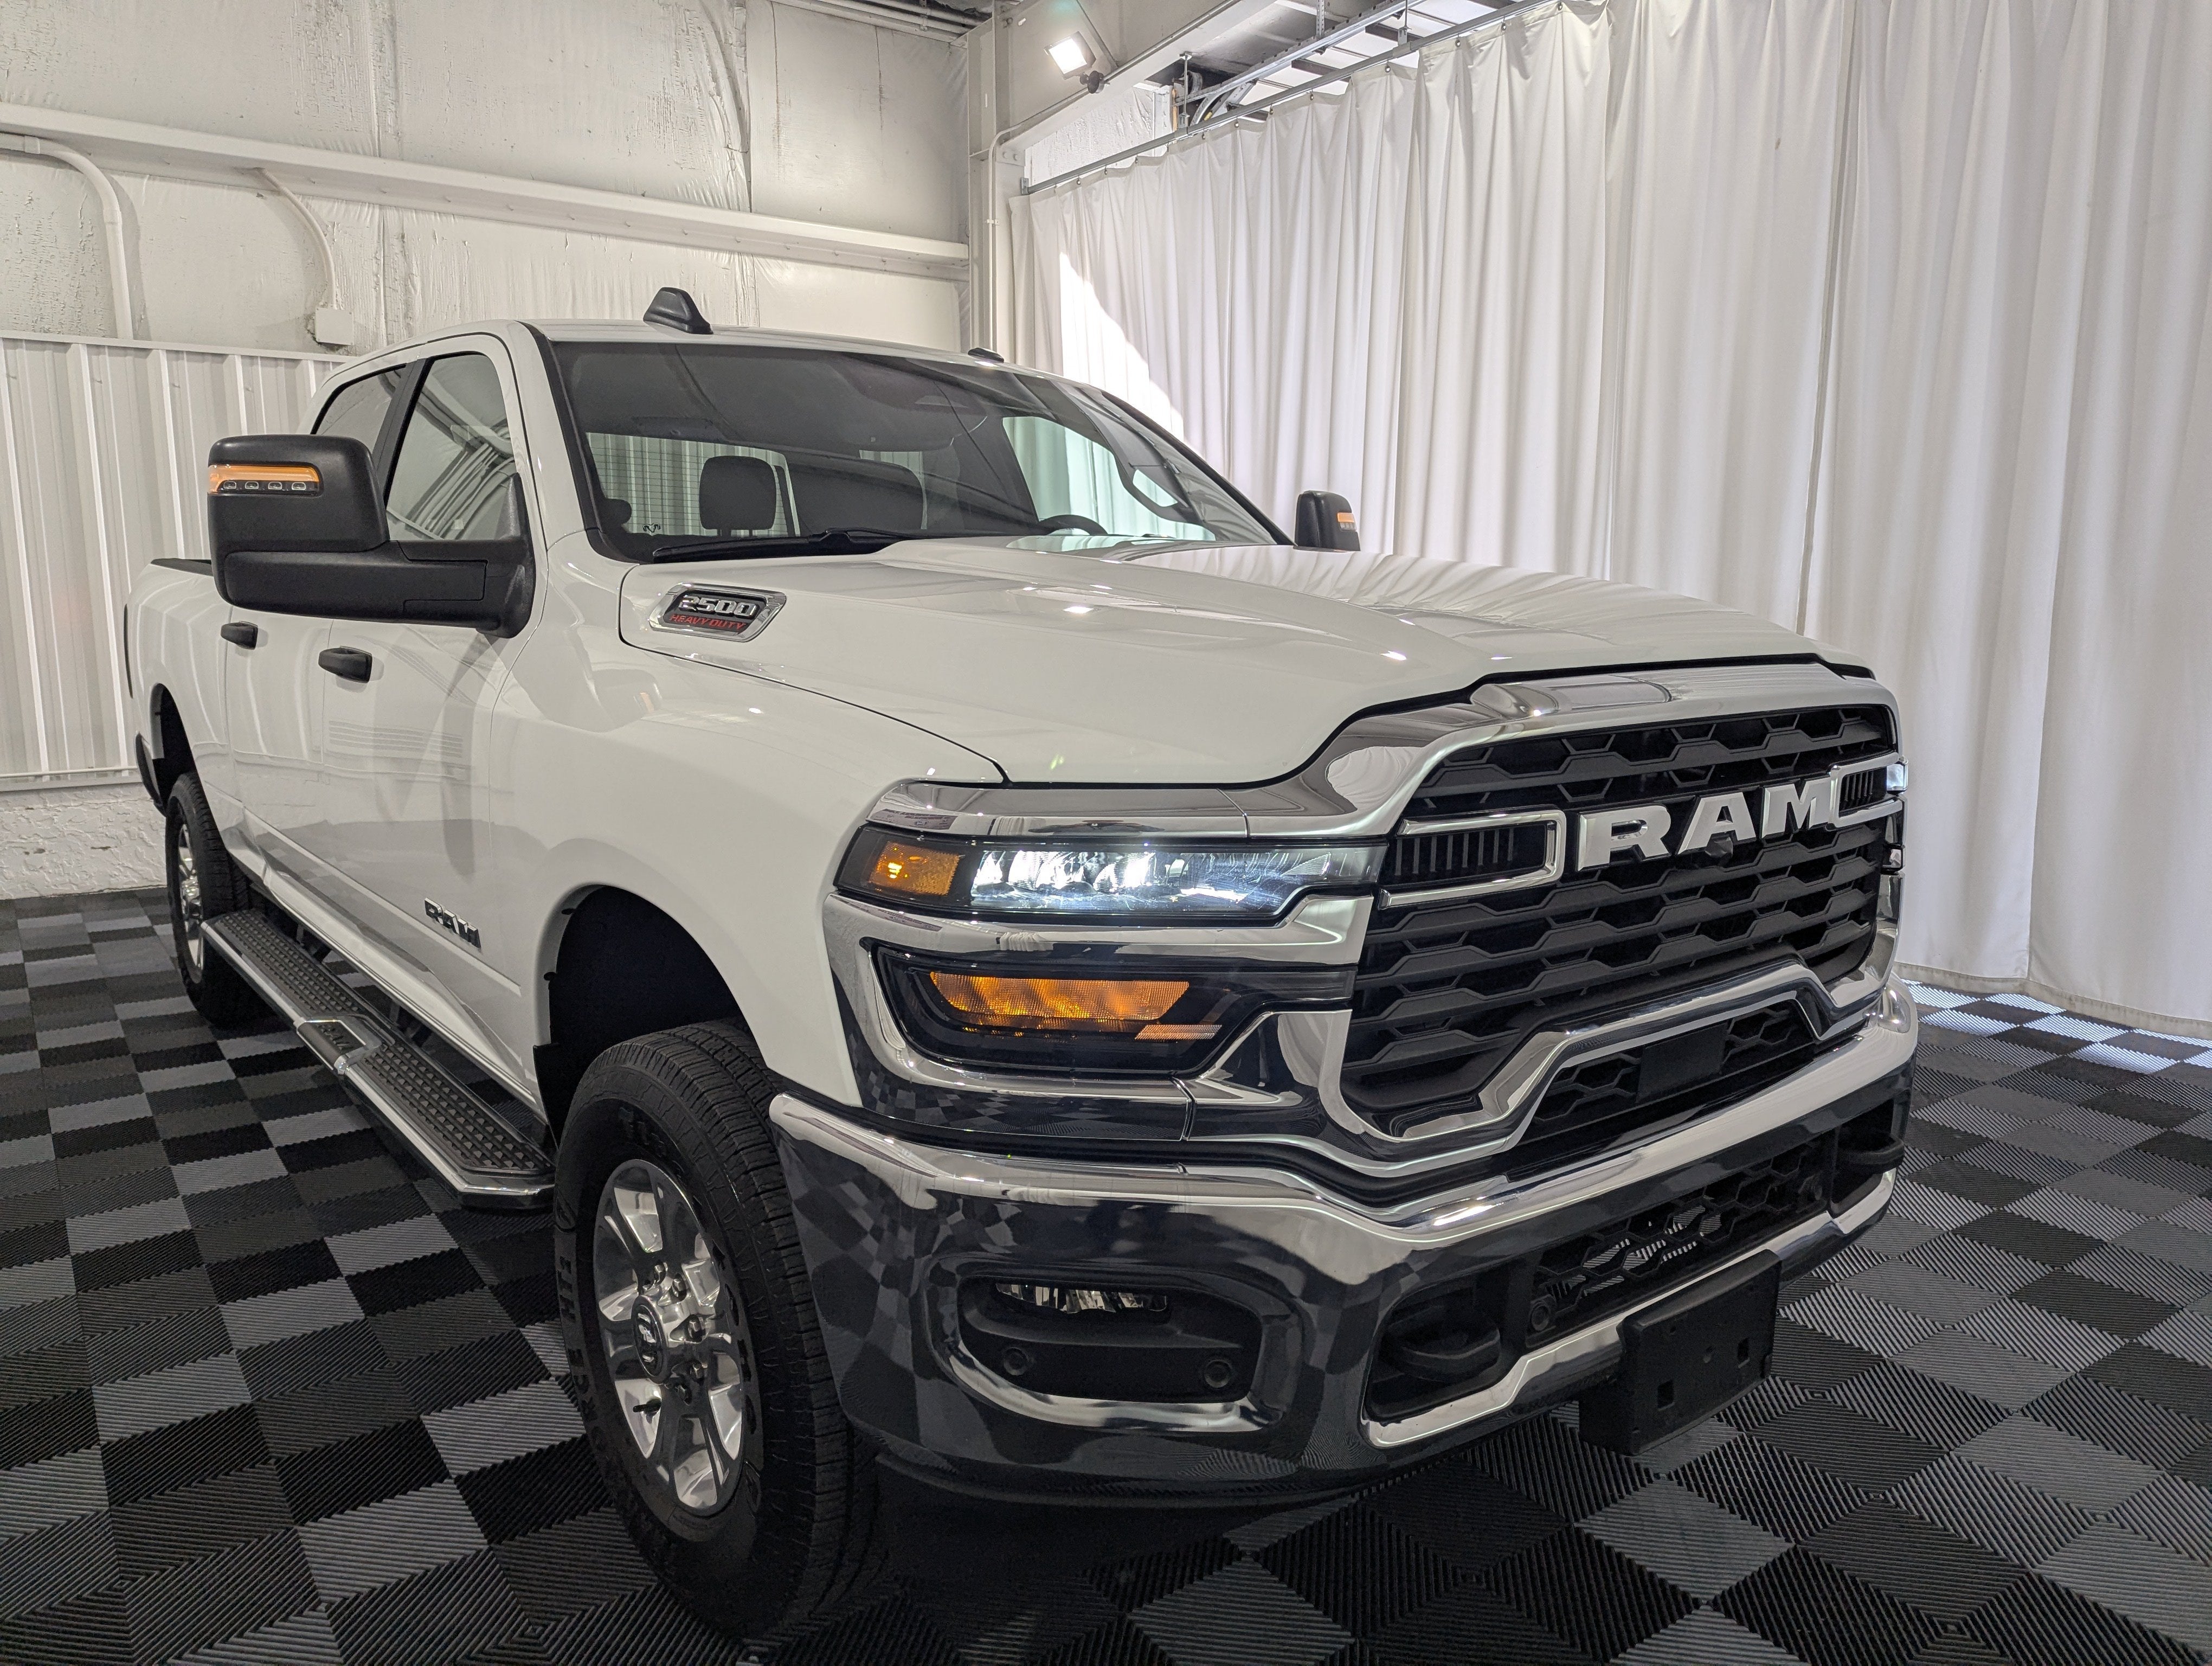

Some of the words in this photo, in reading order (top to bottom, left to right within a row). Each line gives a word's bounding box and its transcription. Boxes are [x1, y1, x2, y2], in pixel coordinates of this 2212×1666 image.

[669, 613, 711, 624] HEAVY
[708, 619, 747, 630] DUTY
[678, 595, 757, 617] 2500
[1577, 777, 1831, 872] RAM
[424, 898, 481, 949] RAM
